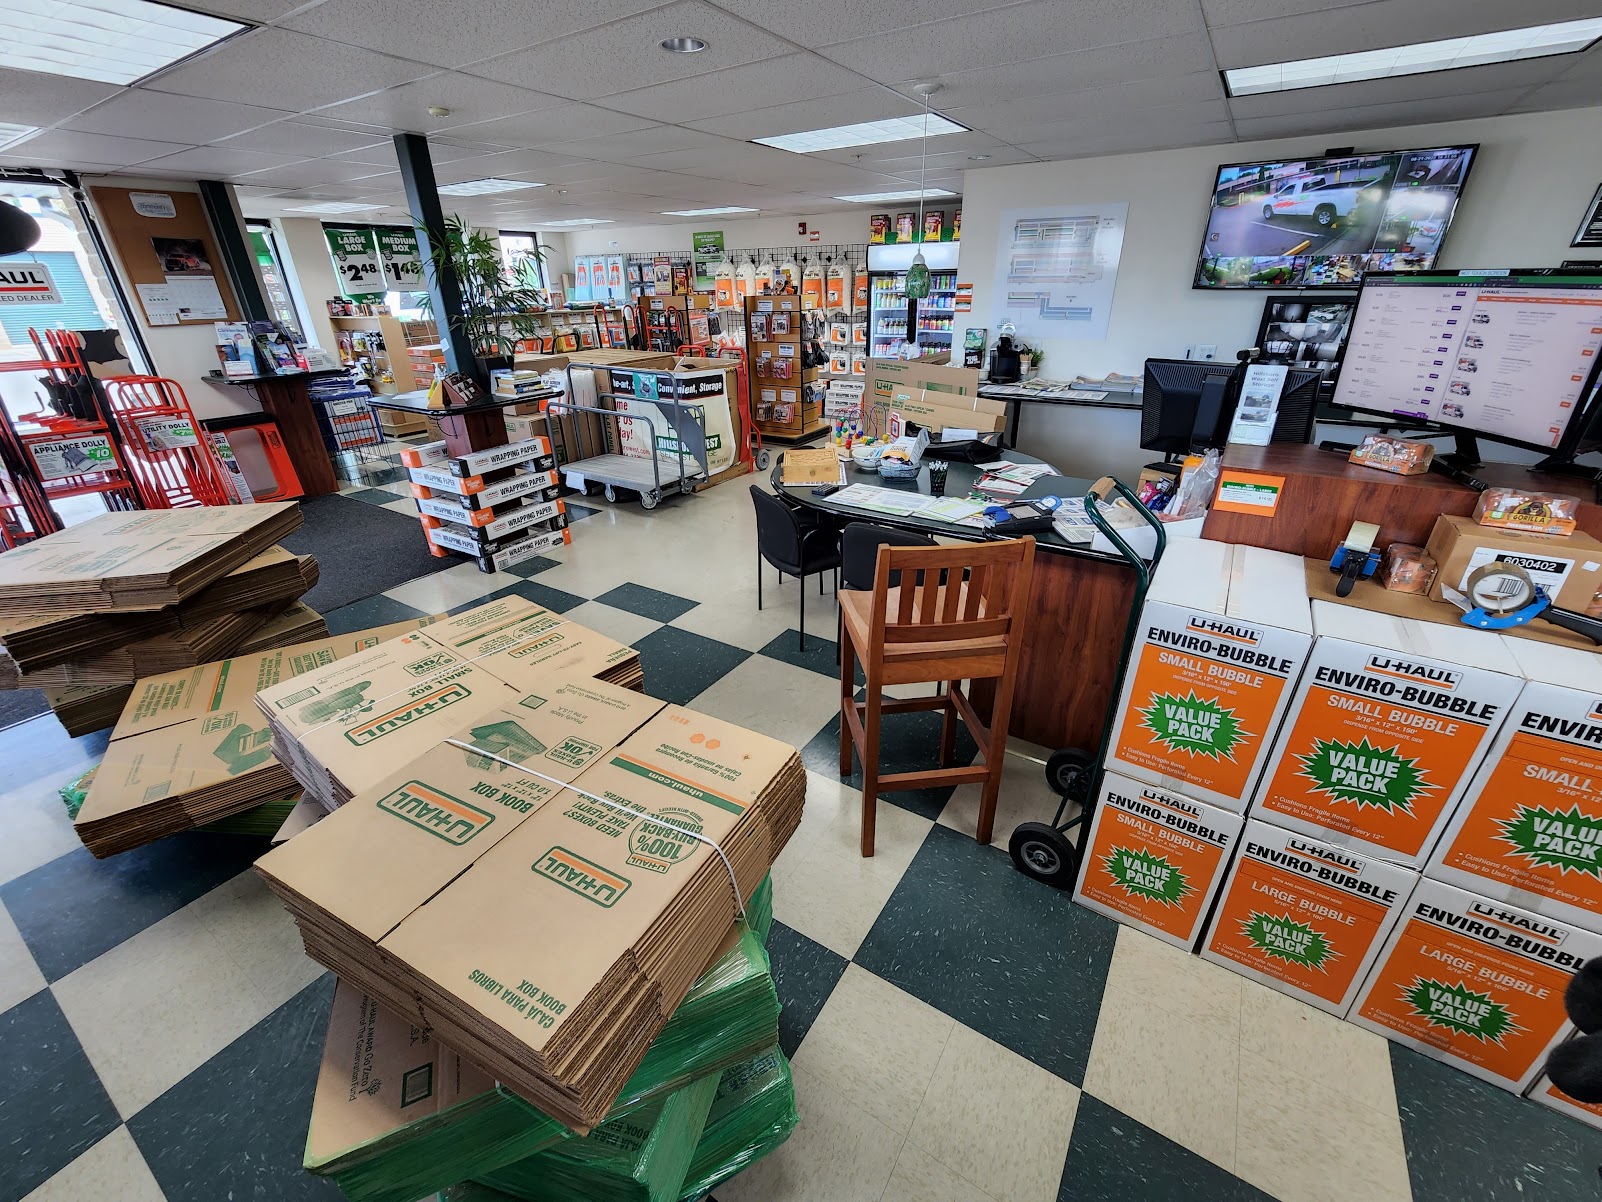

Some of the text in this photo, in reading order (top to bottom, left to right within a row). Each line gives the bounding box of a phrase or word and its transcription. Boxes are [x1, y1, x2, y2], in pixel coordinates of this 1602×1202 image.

[338, 236, 366, 244] LARGE
[345, 244, 364, 252] BOX
[382, 236, 416, 245] MEDIUM
[392, 244, 410, 252] BOX
[16, 294, 54, 302] DEALER
[700, 381, 722, 392] Storage
[141, 425, 168, 434] UTILITY
[168, 422, 190, 430] DOLLY
[34, 439, 106, 455] APPLIANCE DOLLY
[490, 450, 520, 462] WRAPPING
[520, 444, 538, 456] PAPER
[423, 473, 456, 486] WRAPPING PAPER
[500, 482, 528, 496] WRAPPING
[529, 476, 546, 487] PAPER
[433, 506, 466, 519] WRAPPING PAPER
[508, 506, 552, 527] WRAPPING PAPER
[1512, 514, 1546, 524] GORILLA
[443, 535, 474, 550] WRAPPING PAPER
[508, 537, 550, 556] WRAPPING PAPER
[1504, 556, 1557, 572] 6030402
[1190, 618, 1259, 642] U-HAUL
[514, 634, 563, 656] U-HAUL
[1148, 626, 1293, 674] ENVIRO-BUBBLE
[410, 659, 436, 672] OK
[434, 667, 473, 686] SMALL
[1158, 652, 1264, 688] SMALL BUBBLE
[1370, 656, 1459, 684] U-HAUL
[408, 685, 434, 698] BOX
[1315, 666, 1498, 720] ENVIRO-BUBBLE
[357, 689, 463, 738] U-HAUL
[550, 710, 585, 724] Proudly Made
[1164, 704, 1222, 728] VALUE
[1328, 694, 1460, 736] SMALL BUBBLE
[1168, 720, 1216, 743] PACK
[1343, 719, 1424, 744] DISPENSE FROM OPPOSITE SIDE
[554, 749, 576, 760] BOXES
[562, 742, 582, 756] OK
[655, 748, 684, 762] Recompra
[660, 743, 742, 778] Cajas Recibo
[1127, 747, 1151, 760] Cushions
[1126, 752, 1203, 784] Easy Every
[1329, 750, 1400, 779] VALUE
[1560, 756, 1594, 769] OPEN AND
[516, 778, 552, 795] 1.0 CU FT
[648, 772, 704, 798] uhaul.com
[719, 772, 737, 782] 100%
[1330, 768, 1390, 794] PACK
[1522, 764, 1594, 793] SMALL
[469, 782, 534, 814] BOOK BOX
[604, 790, 647, 814] the Extras.
[1143, 790, 1201, 816] U-HAUL
[1556, 787, 1582, 797] 3/16"
[392, 792, 475, 839] U-HAUL
[572, 802, 630, 830] TAKE PLENTY!
[614, 806, 640, 822] We'll
[1107, 792, 1229, 846] ENVIRO-BUBBLE
[1276, 802, 1292, 814] Easy
[1300, 810, 1315, 820] Use:
[1316, 814, 1350, 831] Perforated
[1350, 826, 1371, 838] Every
[1279, 796, 1350, 824] Cushions Fragile Items
[562, 809, 623, 838] NEED BOXES?
[1116, 813, 1206, 854] SMALL BUBBLE
[634, 834, 684, 860] 100%
[1290, 840, 1362, 870] U-HAUL
[1533, 833, 1601, 861] PACK
[630, 856, 667, 872] U-HAUL
[1122, 855, 1172, 882] VALUE
[1246, 842, 1398, 904] ENVIRO-BUBBLE
[1465, 853, 1556, 886] Cushions Fragile Items
[544, 856, 617, 902] U-HAUL
[1126, 869, 1166, 892] PACK
[1461, 860, 1480, 872] Easy
[1491, 868, 1510, 879] Use:
[1510, 875, 1554, 894] Perforated
[1554, 889, 1580, 902] Every
[1582, 898, 1599, 906] 12"
[1252, 880, 1356, 926] LARGE BUBBLE
[1262, 920, 1314, 946] VALUE
[1474, 903, 1564, 940] U-HAUL
[1264, 934, 1308, 956] PACK
[1420, 944, 1550, 1000] LARGE BUBBLE
[468, 969, 556, 1030] CAJÁ PARA LIBROS
[516, 979, 568, 1016] BOOK BOX
[1428, 987, 1492, 1018] VALUE
[1430, 1000, 1484, 1028] PACK
[361, 1027, 375, 1087] AWARD Go Zero
[349, 1038, 364, 1102] Conservation Fund
